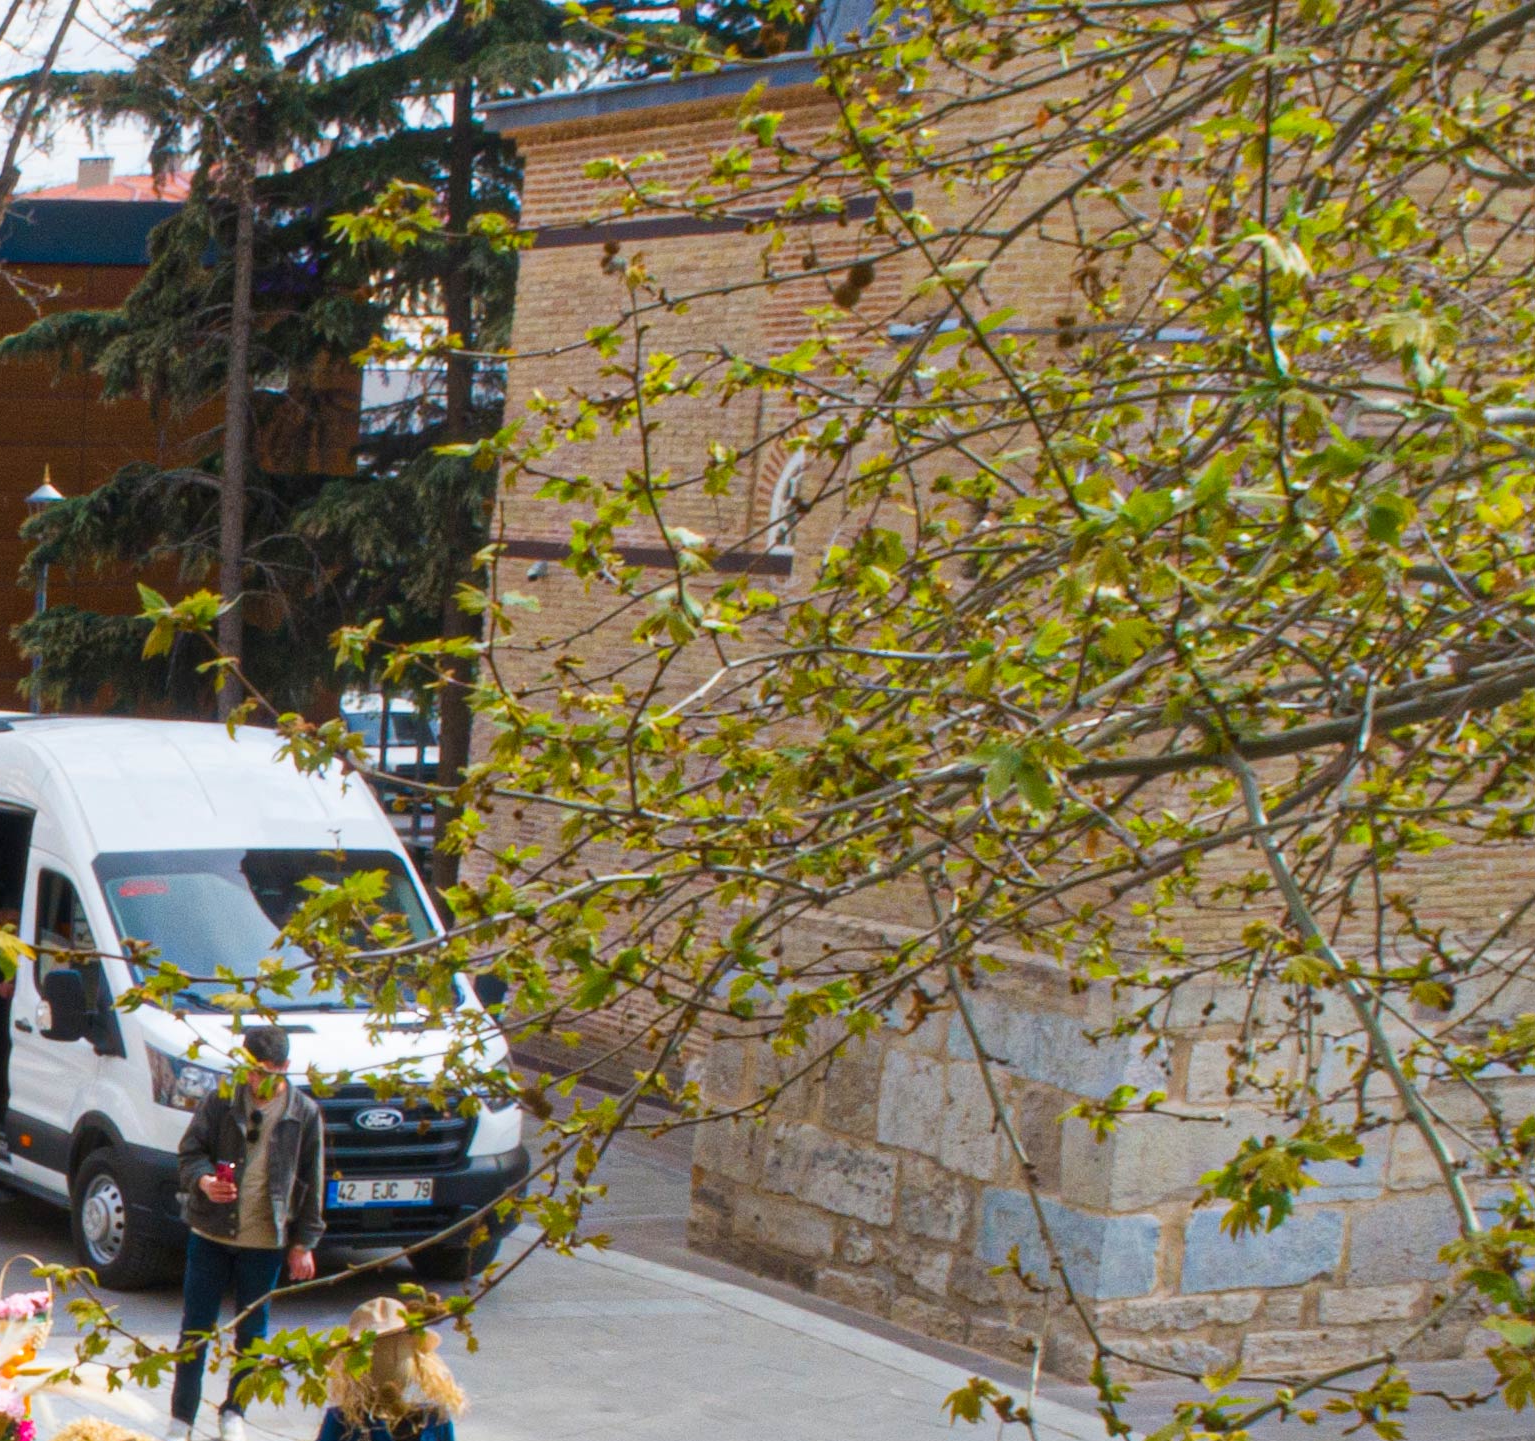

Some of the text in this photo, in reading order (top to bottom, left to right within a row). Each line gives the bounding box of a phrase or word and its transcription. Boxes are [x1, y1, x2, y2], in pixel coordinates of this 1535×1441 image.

[337, 1181, 431, 1201] 42 EJC 79
